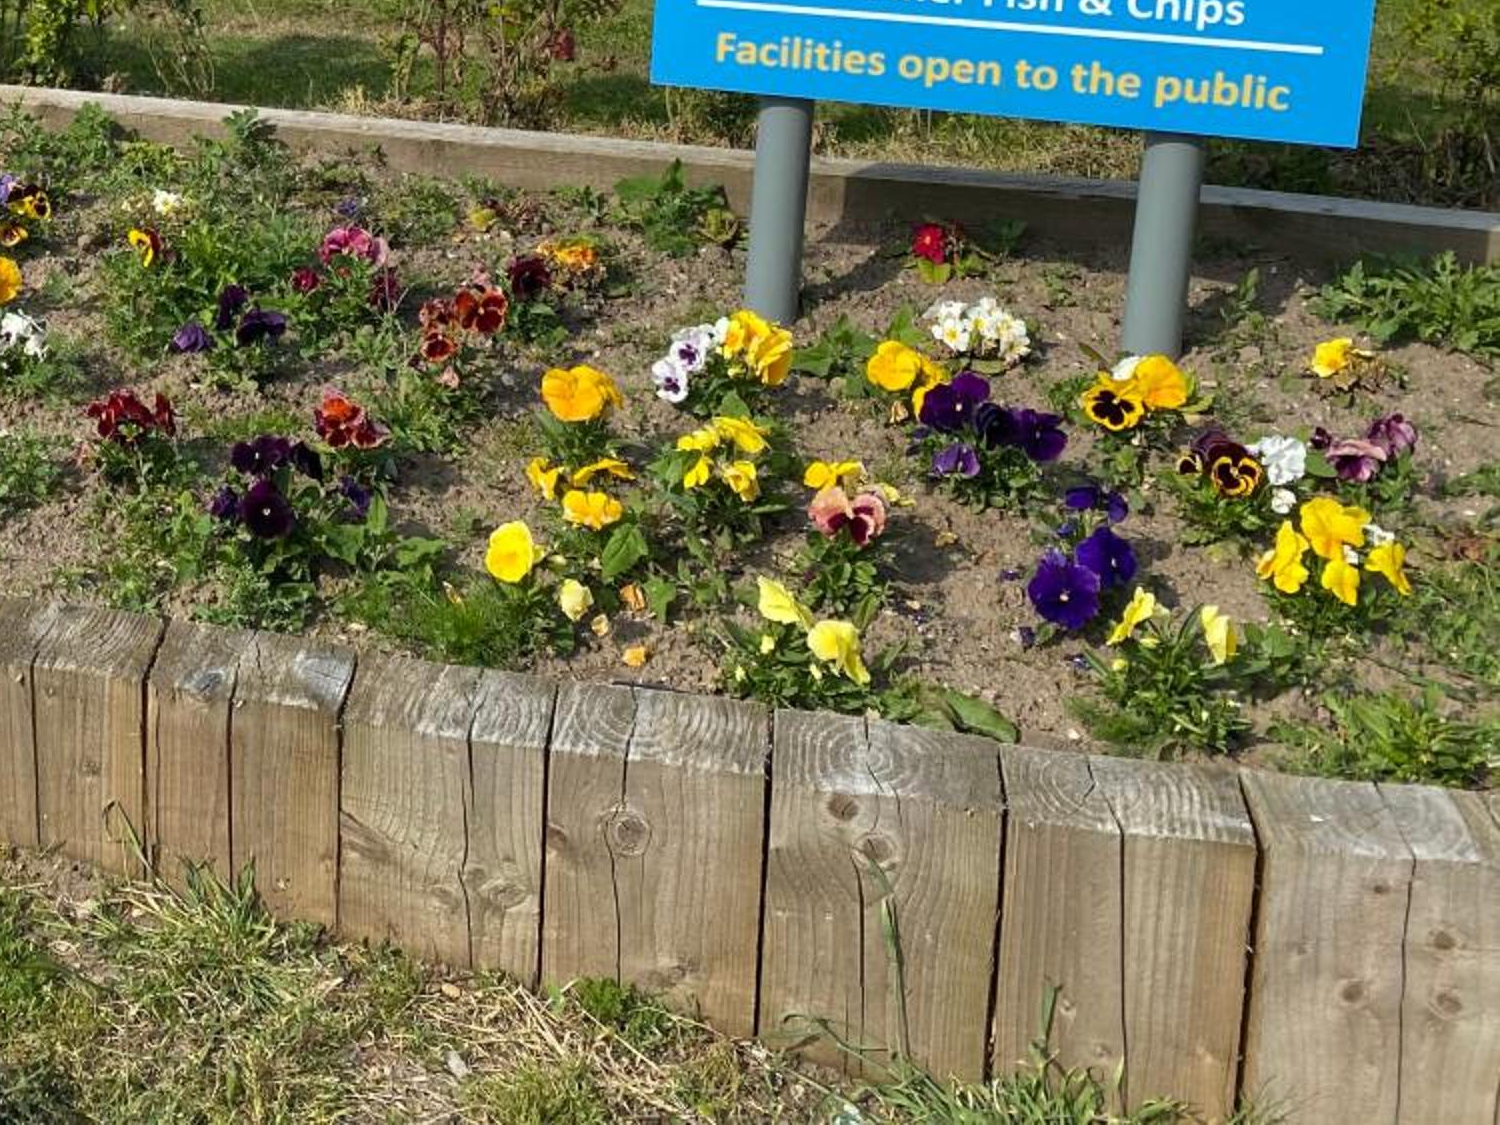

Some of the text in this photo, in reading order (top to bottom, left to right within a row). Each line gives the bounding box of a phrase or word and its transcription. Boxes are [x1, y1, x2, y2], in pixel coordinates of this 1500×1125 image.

[716, 32, 1290, 111] Facilities open to the public
